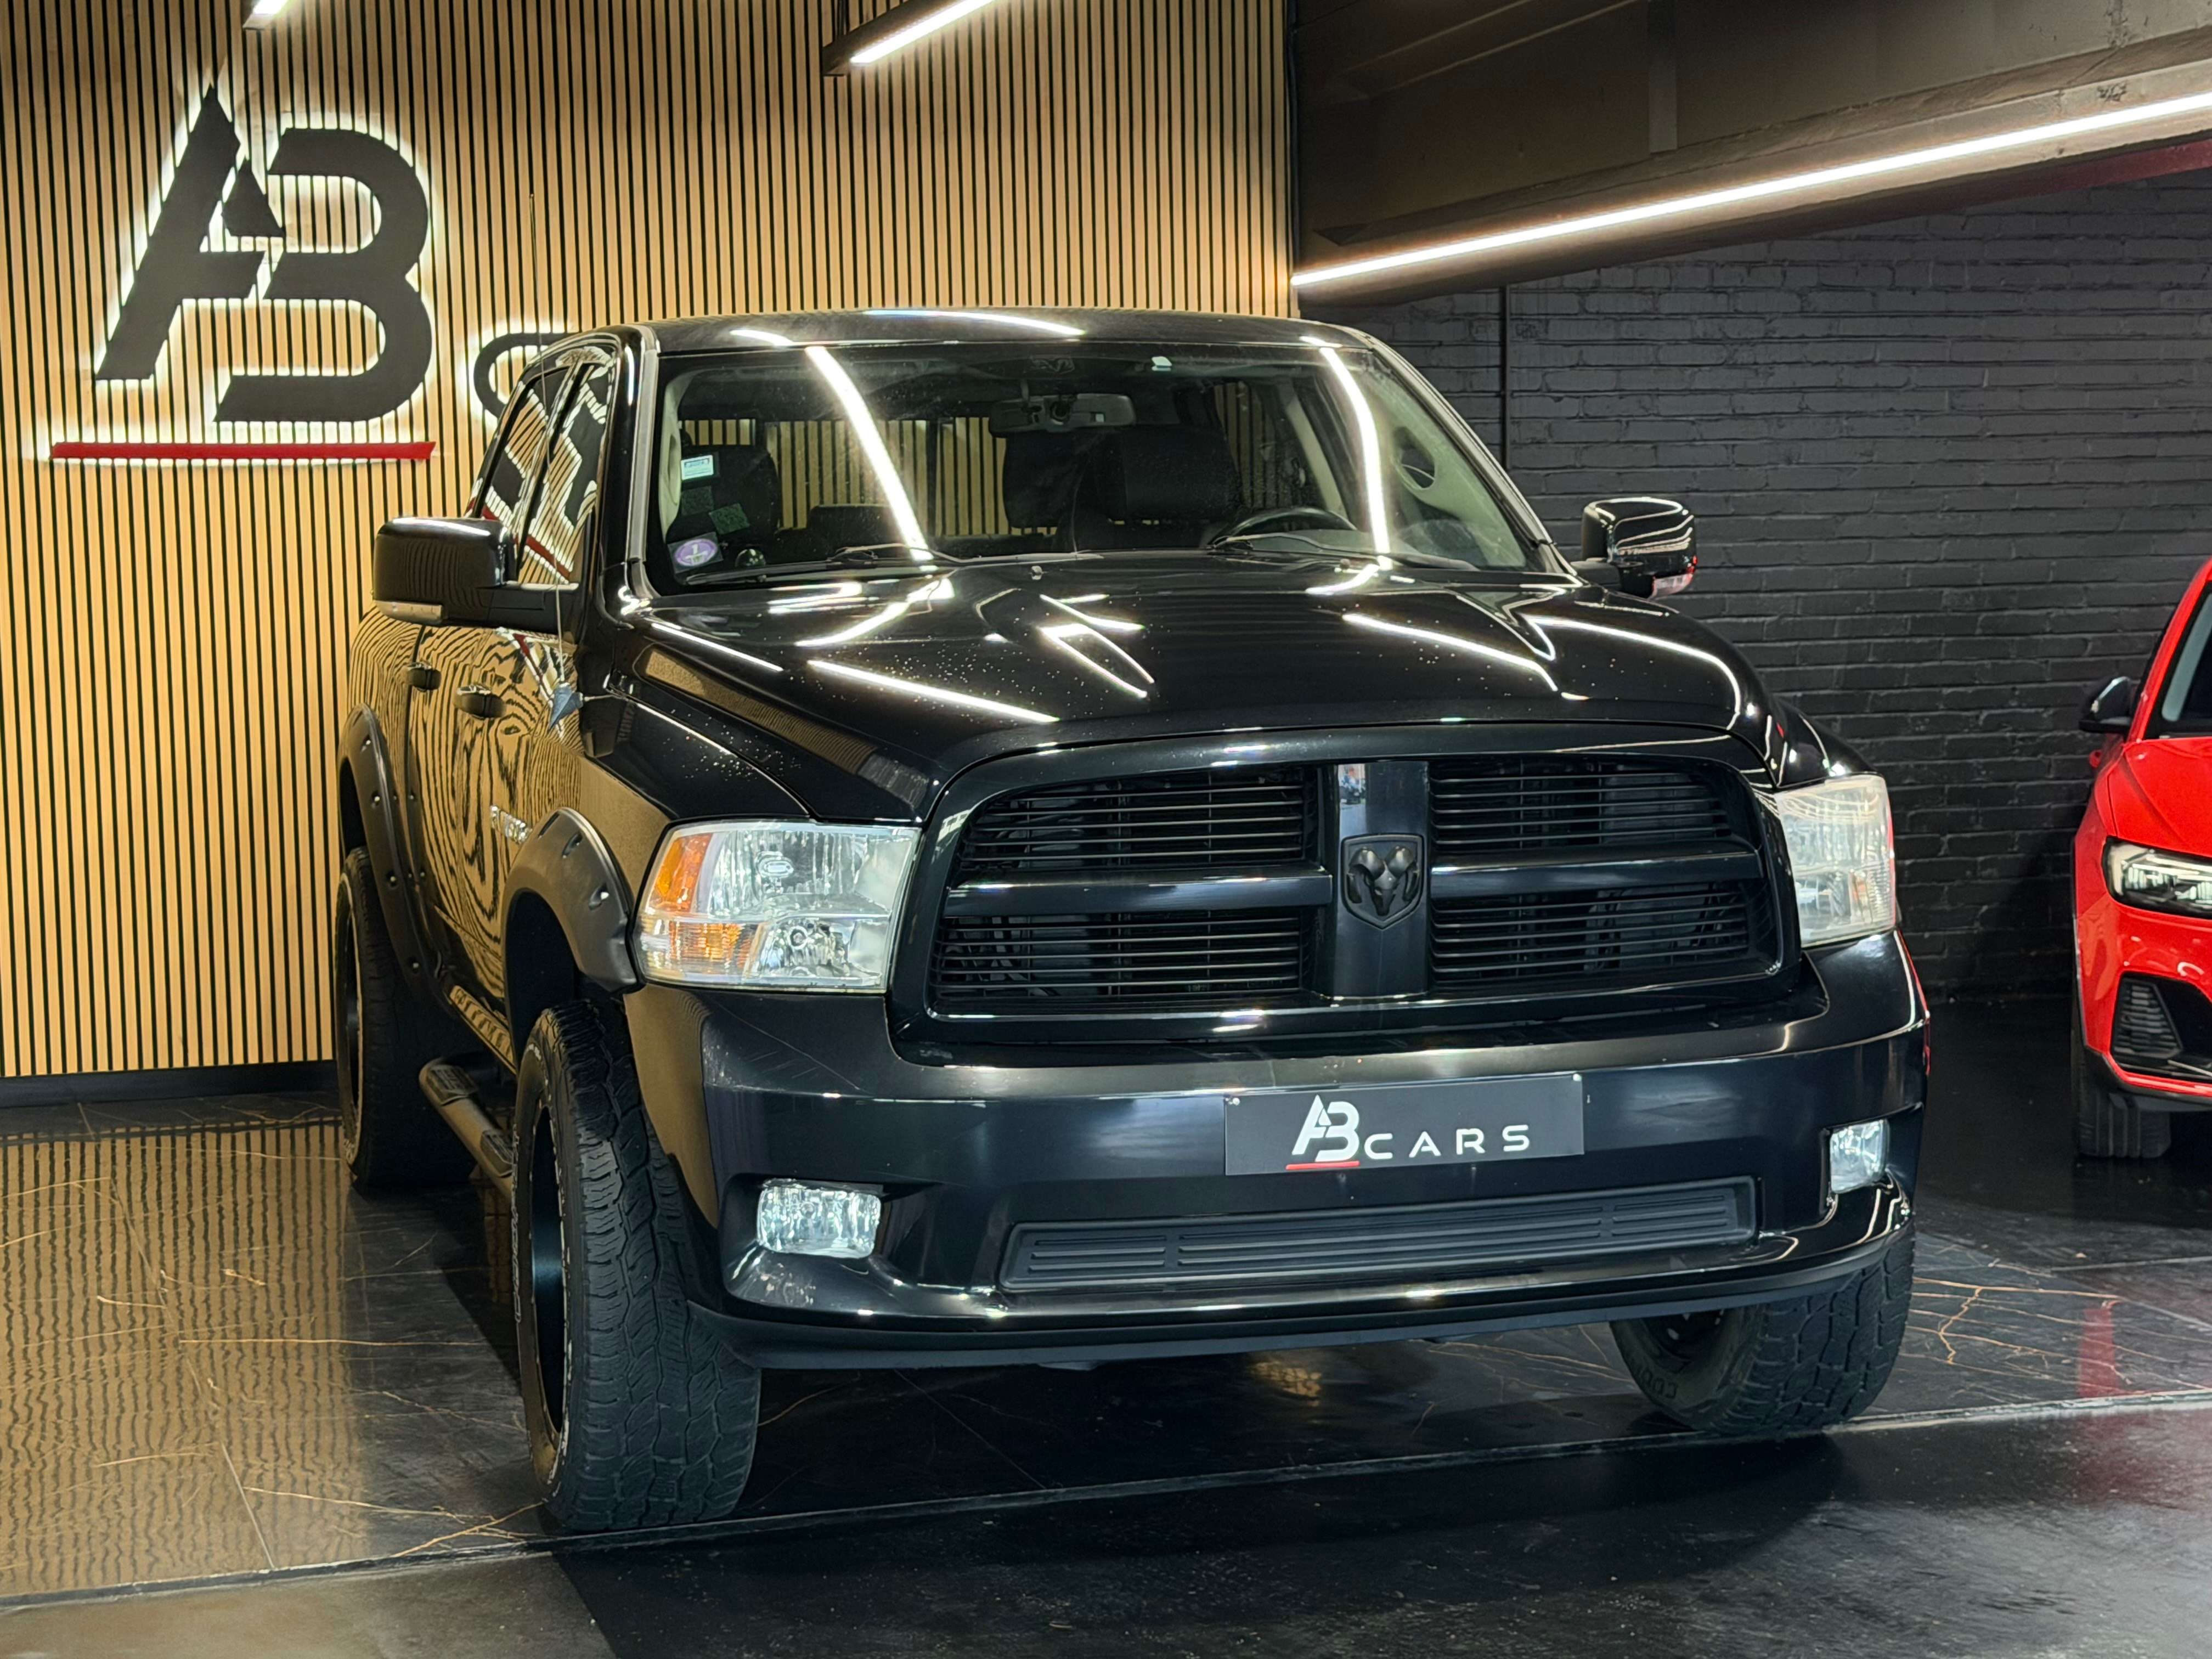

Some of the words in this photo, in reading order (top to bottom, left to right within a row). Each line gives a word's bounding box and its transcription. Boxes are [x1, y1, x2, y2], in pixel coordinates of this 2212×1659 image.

[95, 84, 432, 423] AB
[1291, 1094, 1360, 1162] AB
[1364, 1125, 1530, 1159] CARS
